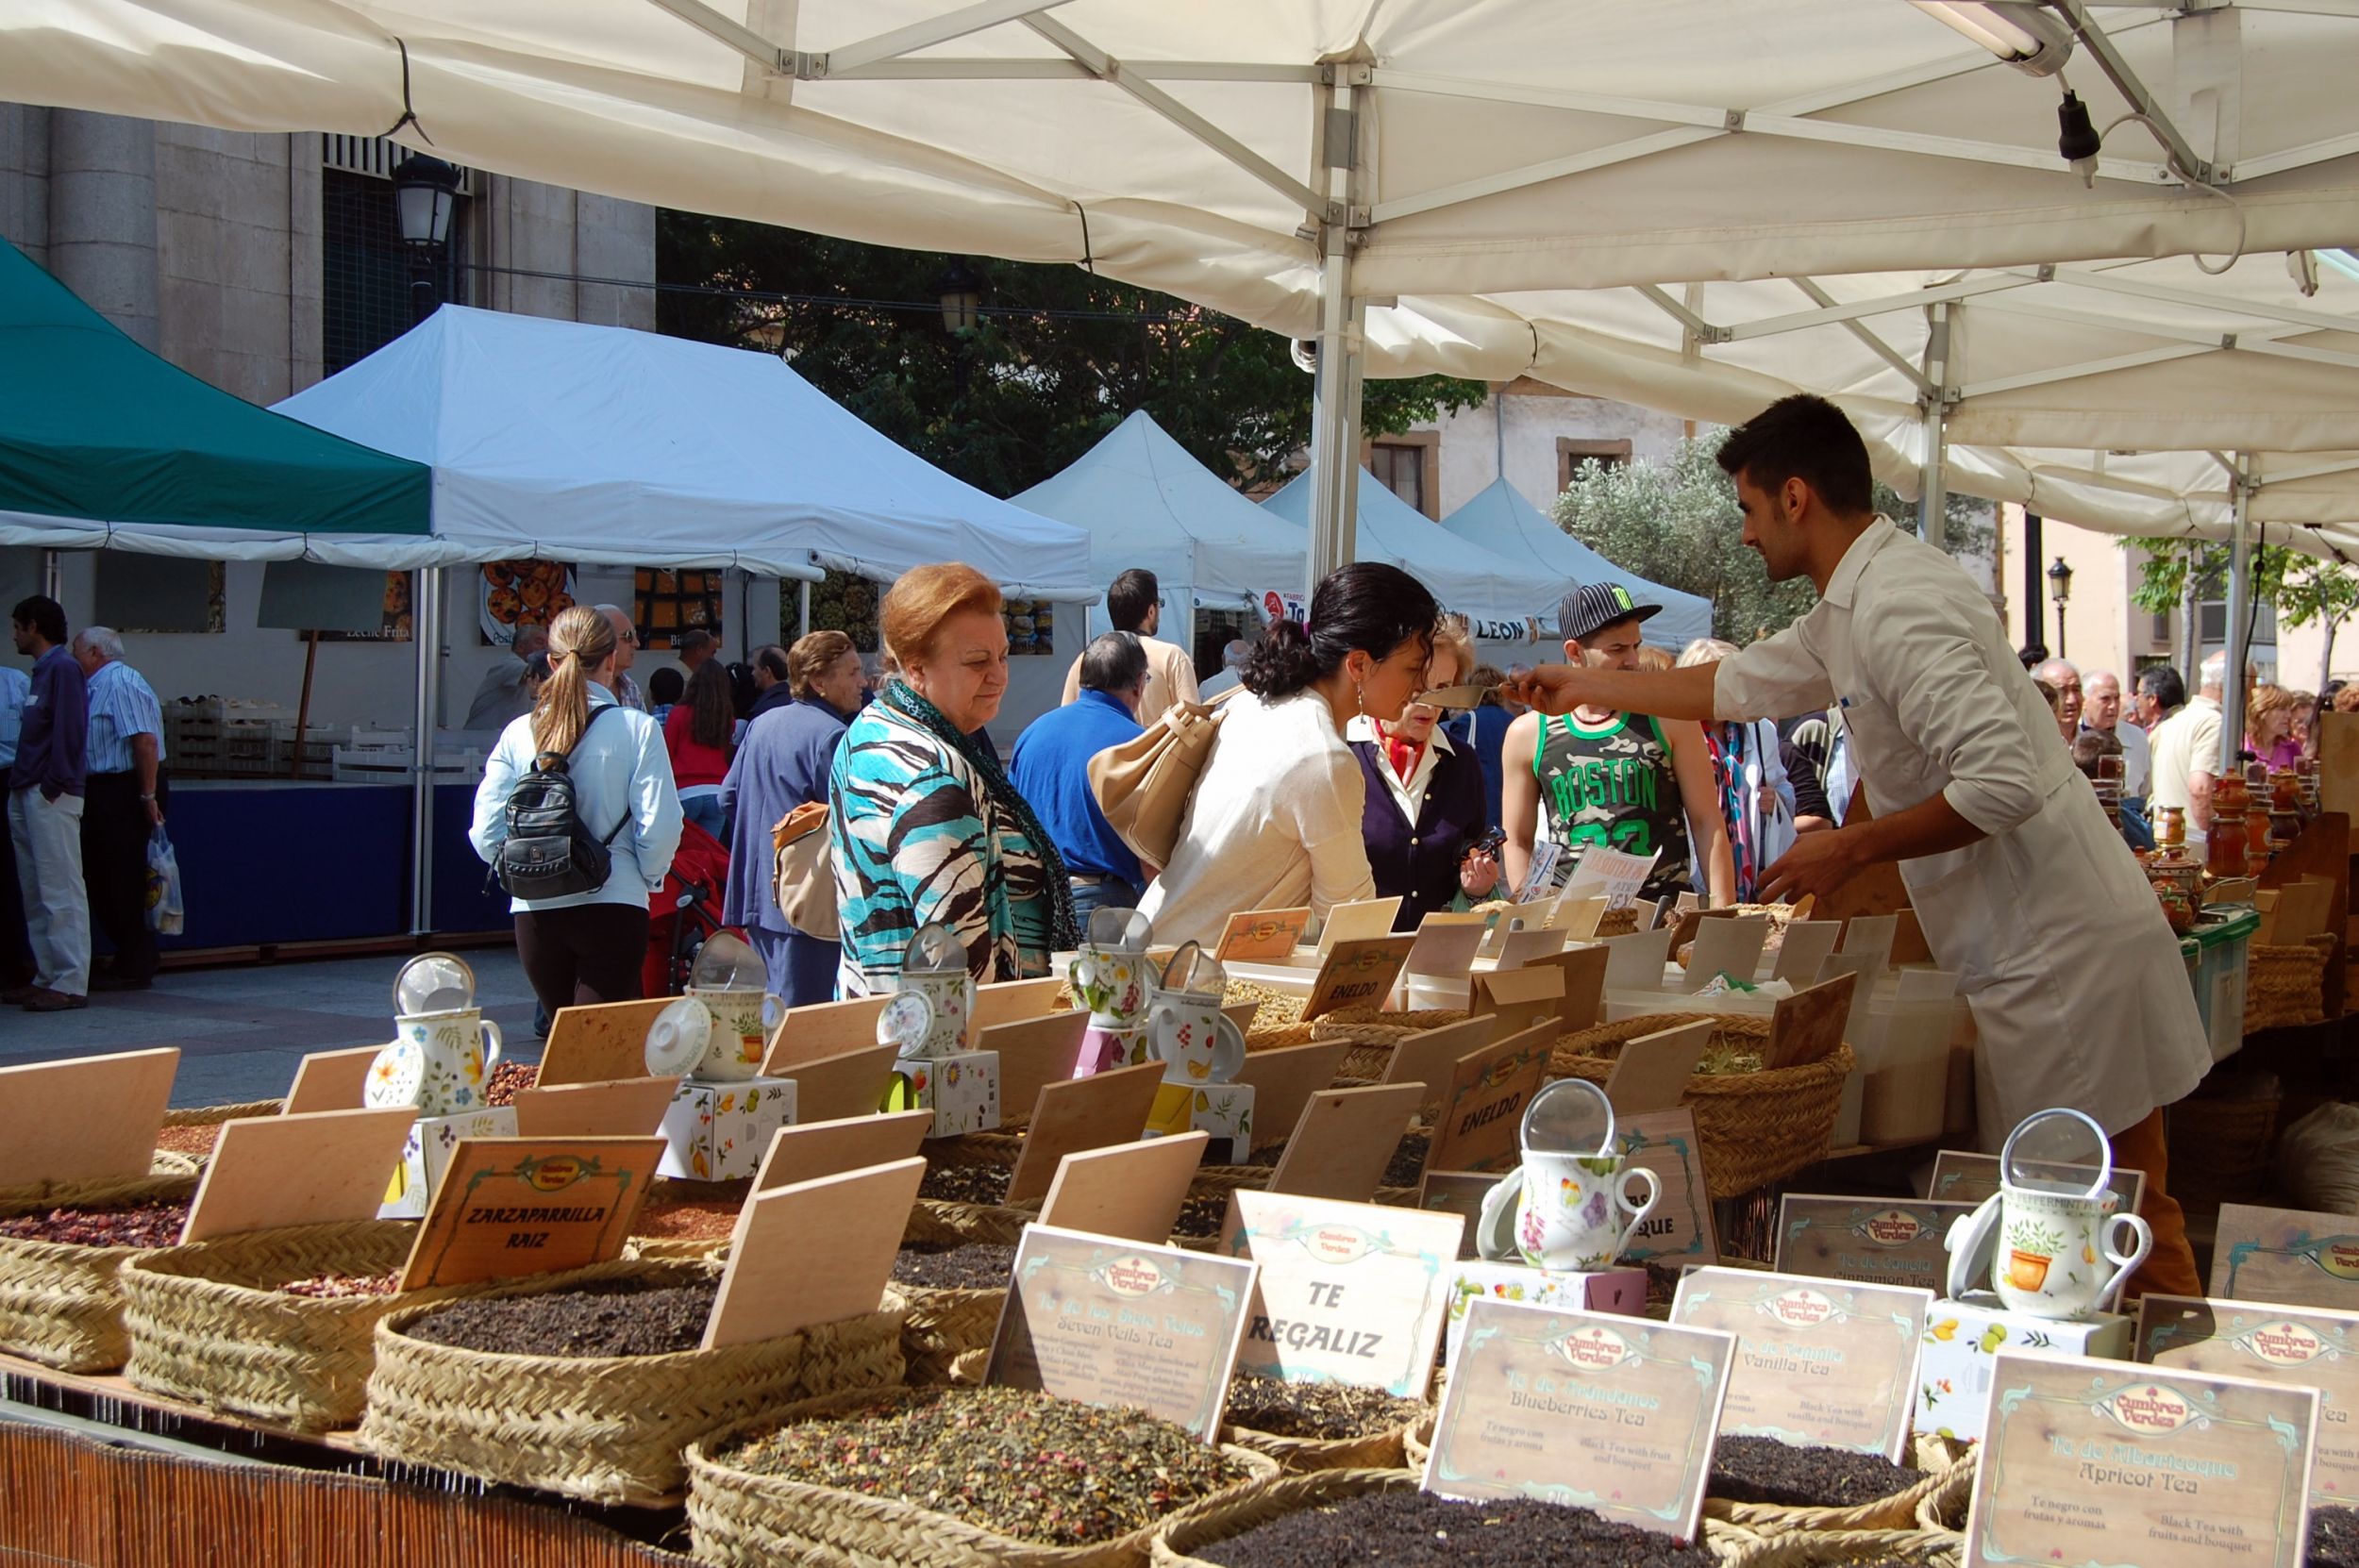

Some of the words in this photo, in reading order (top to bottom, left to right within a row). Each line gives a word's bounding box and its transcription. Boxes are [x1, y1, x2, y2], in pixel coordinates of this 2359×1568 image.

[384, 624, 410, 638] Frita
[1550, 759, 1657, 822] BOSTON
[1330, 981, 1379, 1000] ENELDO
[1458, 1092, 1521, 1137] ENELDO
[466, 1207, 606, 1224] ZARZAPARRILLA
[1869, 1218, 1916, 1232] Cumbres
[506, 1232, 550, 1249] RAIZ
[1873, 1227, 1911, 1241] Verdes
[1109, 1264, 1157, 1282] Cumbres
[1909, 1274, 1935, 1288] Tea
[1112, 1276, 1149, 1293] Verdes
[1309, 1281, 1345, 1309] TE
[1776, 1297, 1828, 1313] Cumbres
[1780, 1307, 1820, 1322] Verdes
[1058, 1316, 1101, 1337] Seven
[1107, 1324, 1140, 1343] Veils
[1147, 1331, 1174, 1349] Tea
[1247, 1314, 1383, 1359] REGALIZ
[2254, 1331, 2316, 1347] Cumbres
[1565, 1335, 1622, 1355] Cumbres
[2259, 1343, 2308, 1359] Verdes
[1570, 1347, 1614, 1365] Verdes
[1744, 1353, 1798, 1372] Vanilla
[1801, 1359, 1830, 1376] Tea
[1510, 1391, 1609, 1421] Blueberries
[1614, 1407, 1646, 1427] Tea
[1800, 1400, 1824, 1413] Black
[1826, 1404, 1843, 1415] Tea
[1844, 1407, 1865, 1418] with
[2116, 1394, 2184, 1416] Cumbres
[1787, 1410, 1815, 1423] vanilla
[2122, 1409, 2175, 1428] Verdes
[1503, 1423, 1526, 1438] negro
[1527, 1426, 1544, 1439] con
[1480, 1433, 1505, 1446] frutas
[1512, 1439, 1544, 1452] aroma
[1581, 1436, 1606, 1451] Black
[1608, 1441, 1627, 1456] Tea
[1628, 1444, 1649, 1459] with
[1649, 1448, 1671, 1461] fruit
[2049, 1434, 2074, 1457] Te
[2080, 1441, 2106, 1460] de
[1593, 1453, 1611, 1465] and
[1611, 1455, 1652, 1473] bouquet
[2332, 1448, 2353, 1459] with
[2079, 1462, 2154, 1491] Apricot
[2162, 1472, 2199, 1494] Tea
[2048, 1497, 2080, 1514] negro
[2083, 1503, 2102, 1515] con
[2024, 1508, 2056, 1524] frutas
[2065, 1517, 2106, 1530] aromas
[2160, 1514, 2191, 1530] Black
[2195, 1519, 2216, 1533] Tea
[2218, 1523, 2244, 1537] with
[2148, 1526, 2180, 1543] fruits
[2182, 1532, 2202, 1546] and
[2203, 1535, 2253, 1555] bouquet
